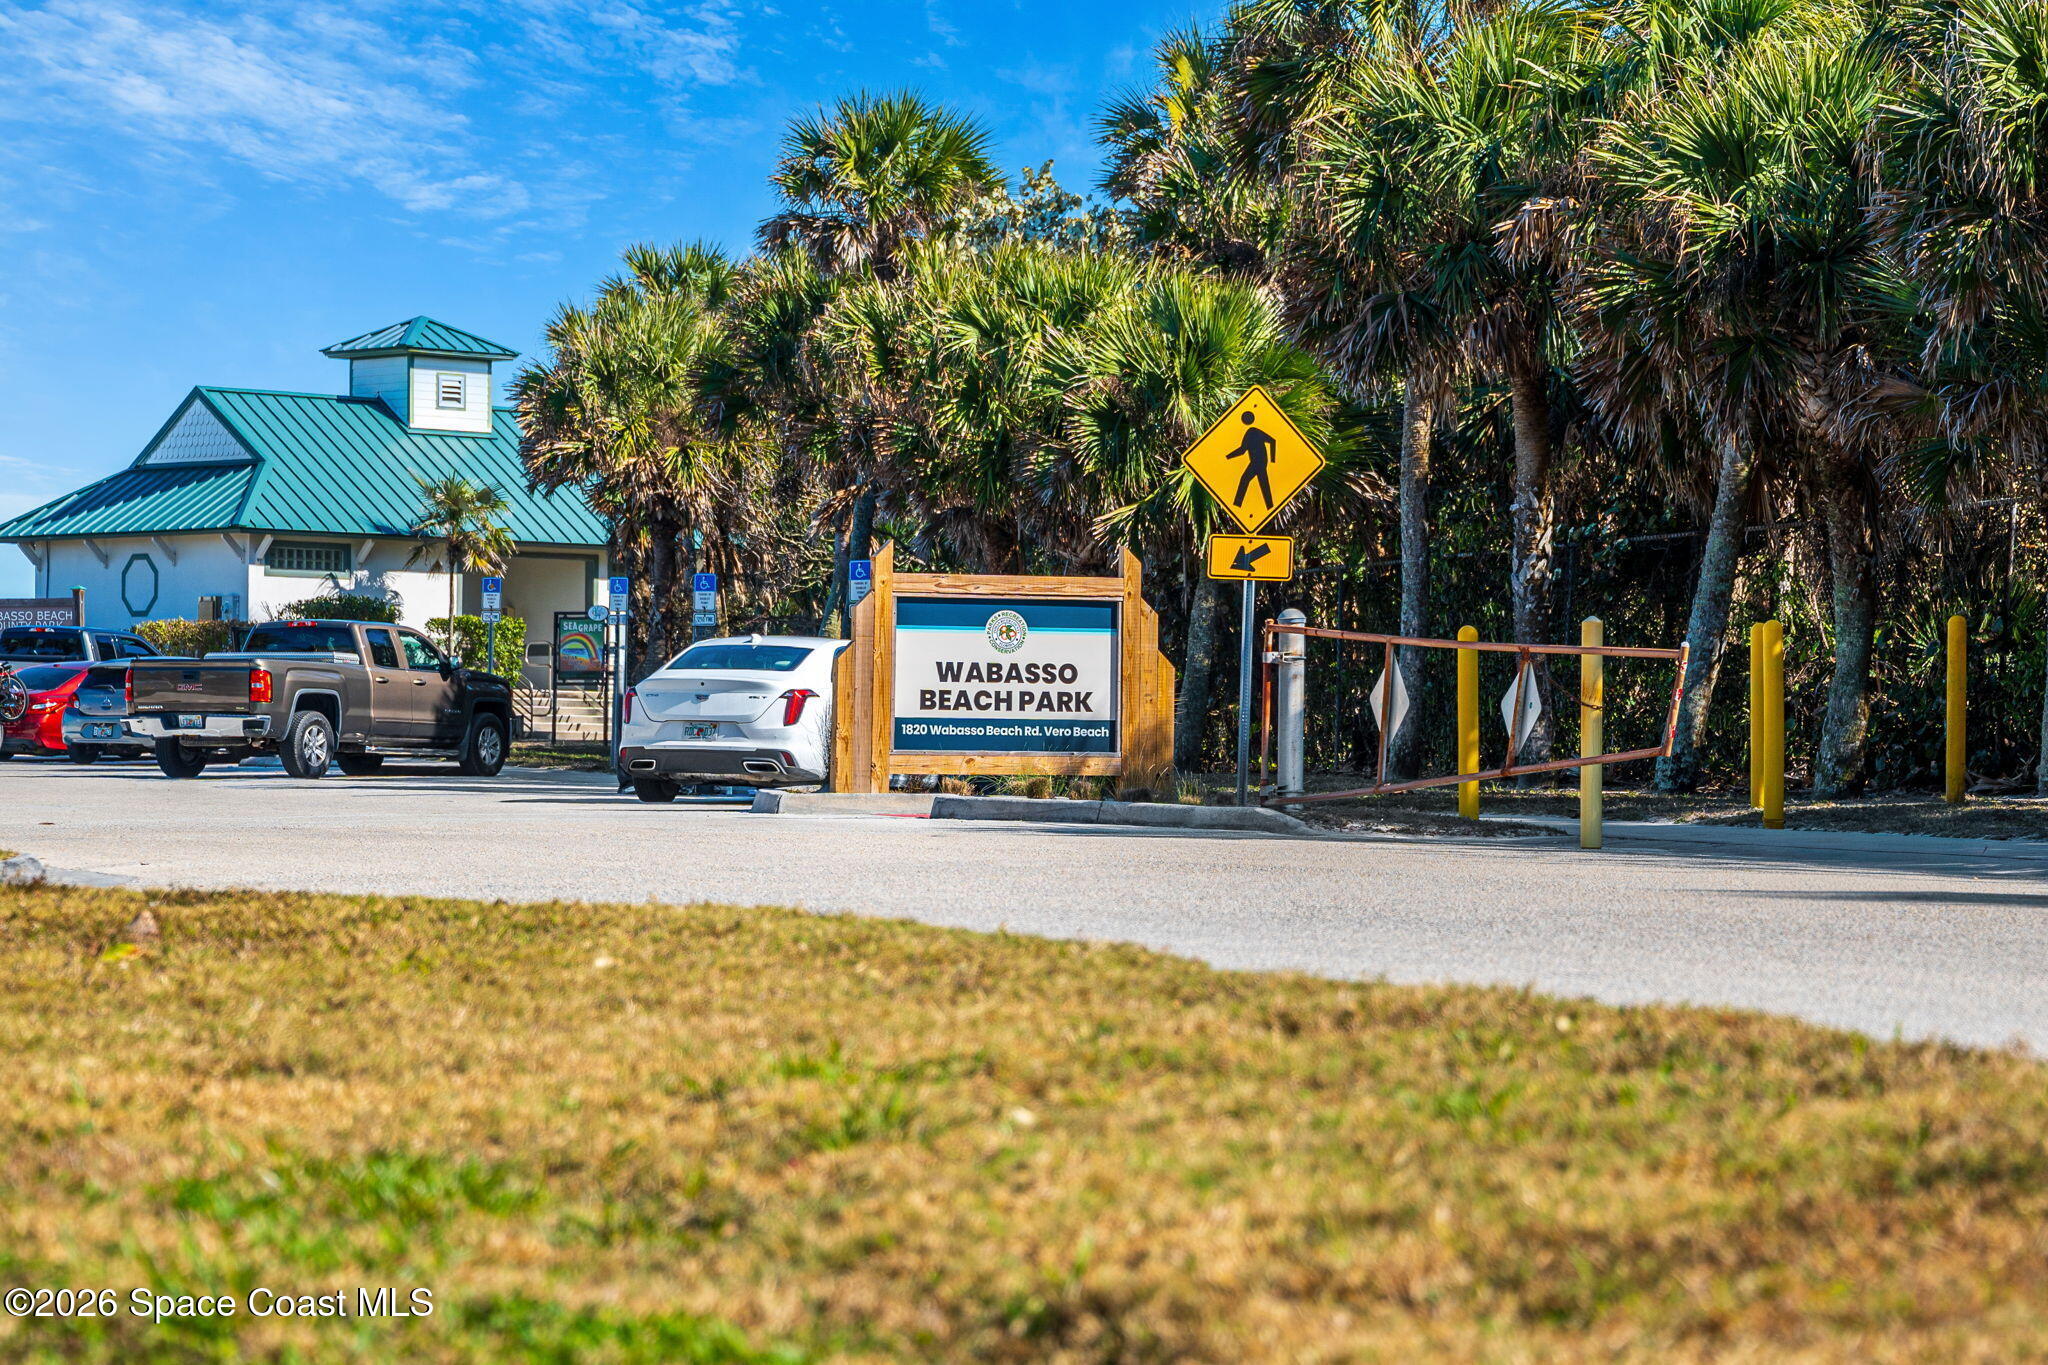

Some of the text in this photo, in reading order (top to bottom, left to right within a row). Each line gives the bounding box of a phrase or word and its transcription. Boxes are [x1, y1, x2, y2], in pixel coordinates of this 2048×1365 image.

[37, 611, 73, 621] BEACH
[1002, 612, 1027, 637] RECREATION
[989, 640, 1024, 654] CONSERVATION
[936, 661, 1079, 684] WABASSO
[919, 689, 1093, 713] BEACH PARK
[901, 723, 1109, 738] 1820 Wabasso Beach Rd. Vero Beach
